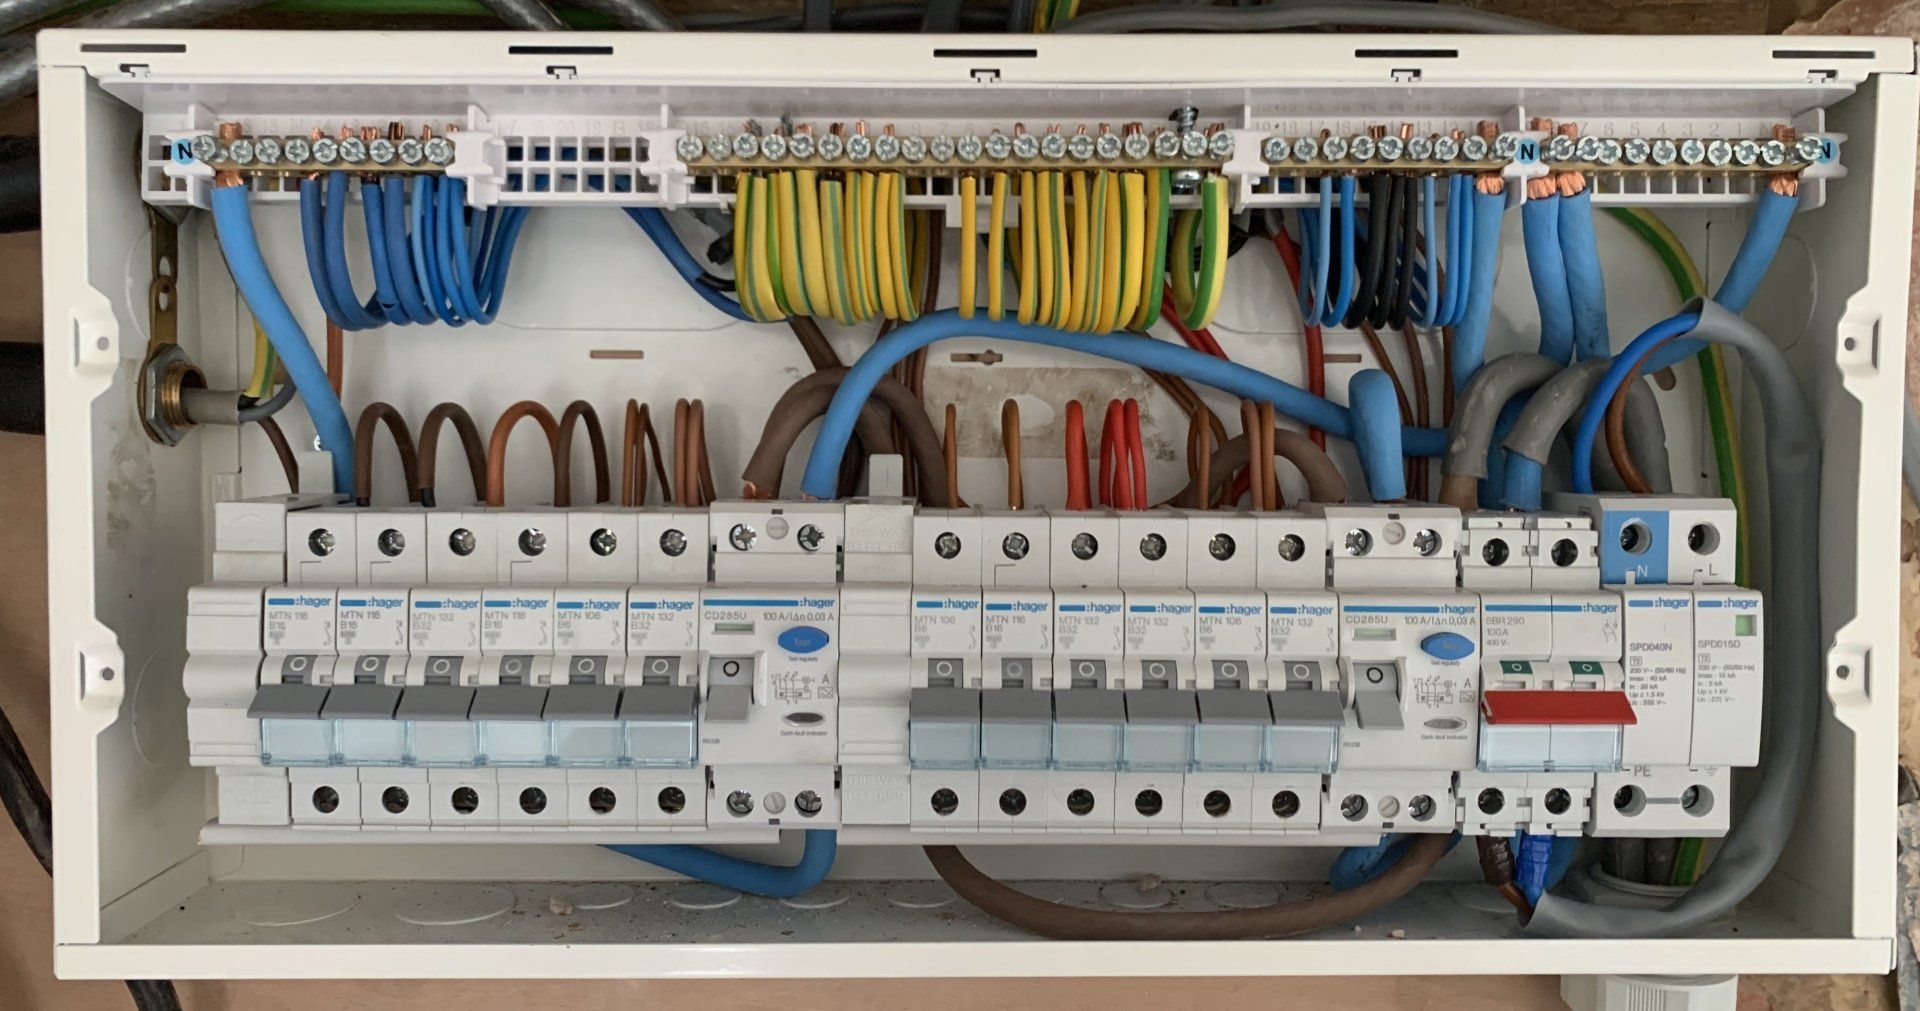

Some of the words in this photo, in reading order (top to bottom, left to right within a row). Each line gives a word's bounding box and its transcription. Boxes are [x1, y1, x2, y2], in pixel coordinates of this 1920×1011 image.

[1520, 143, 1535, 161] N
[1637, 565, 1649, 578] N
[1708, 563, 1718, 576] L
[269, 611, 292, 620] MTN
[340, 610, 364, 620] MTN
[412, 612, 436, 621] MTN
[485, 611, 509, 620] MTN
[557, 611, 581, 620] MTN
[631, 612, 655, 621] MTN
[704, 611, 747, 621] CD285U
[914, 615, 937, 624] MTN
[985, 615, 1009, 624] MTN
[1345, 615, 1388, 624] CD285U
[1059, 616, 1081, 625] MTN
[1127, 617, 1151, 626] MTN
[1199, 617, 1222, 625] MTN
[1270, 618, 1294, 627] MTN
[1629, 642, 1673, 652] SPD040N
[1697, 639, 1741, 649] SPD015D
[1633, 765, 1652, 777] PE
